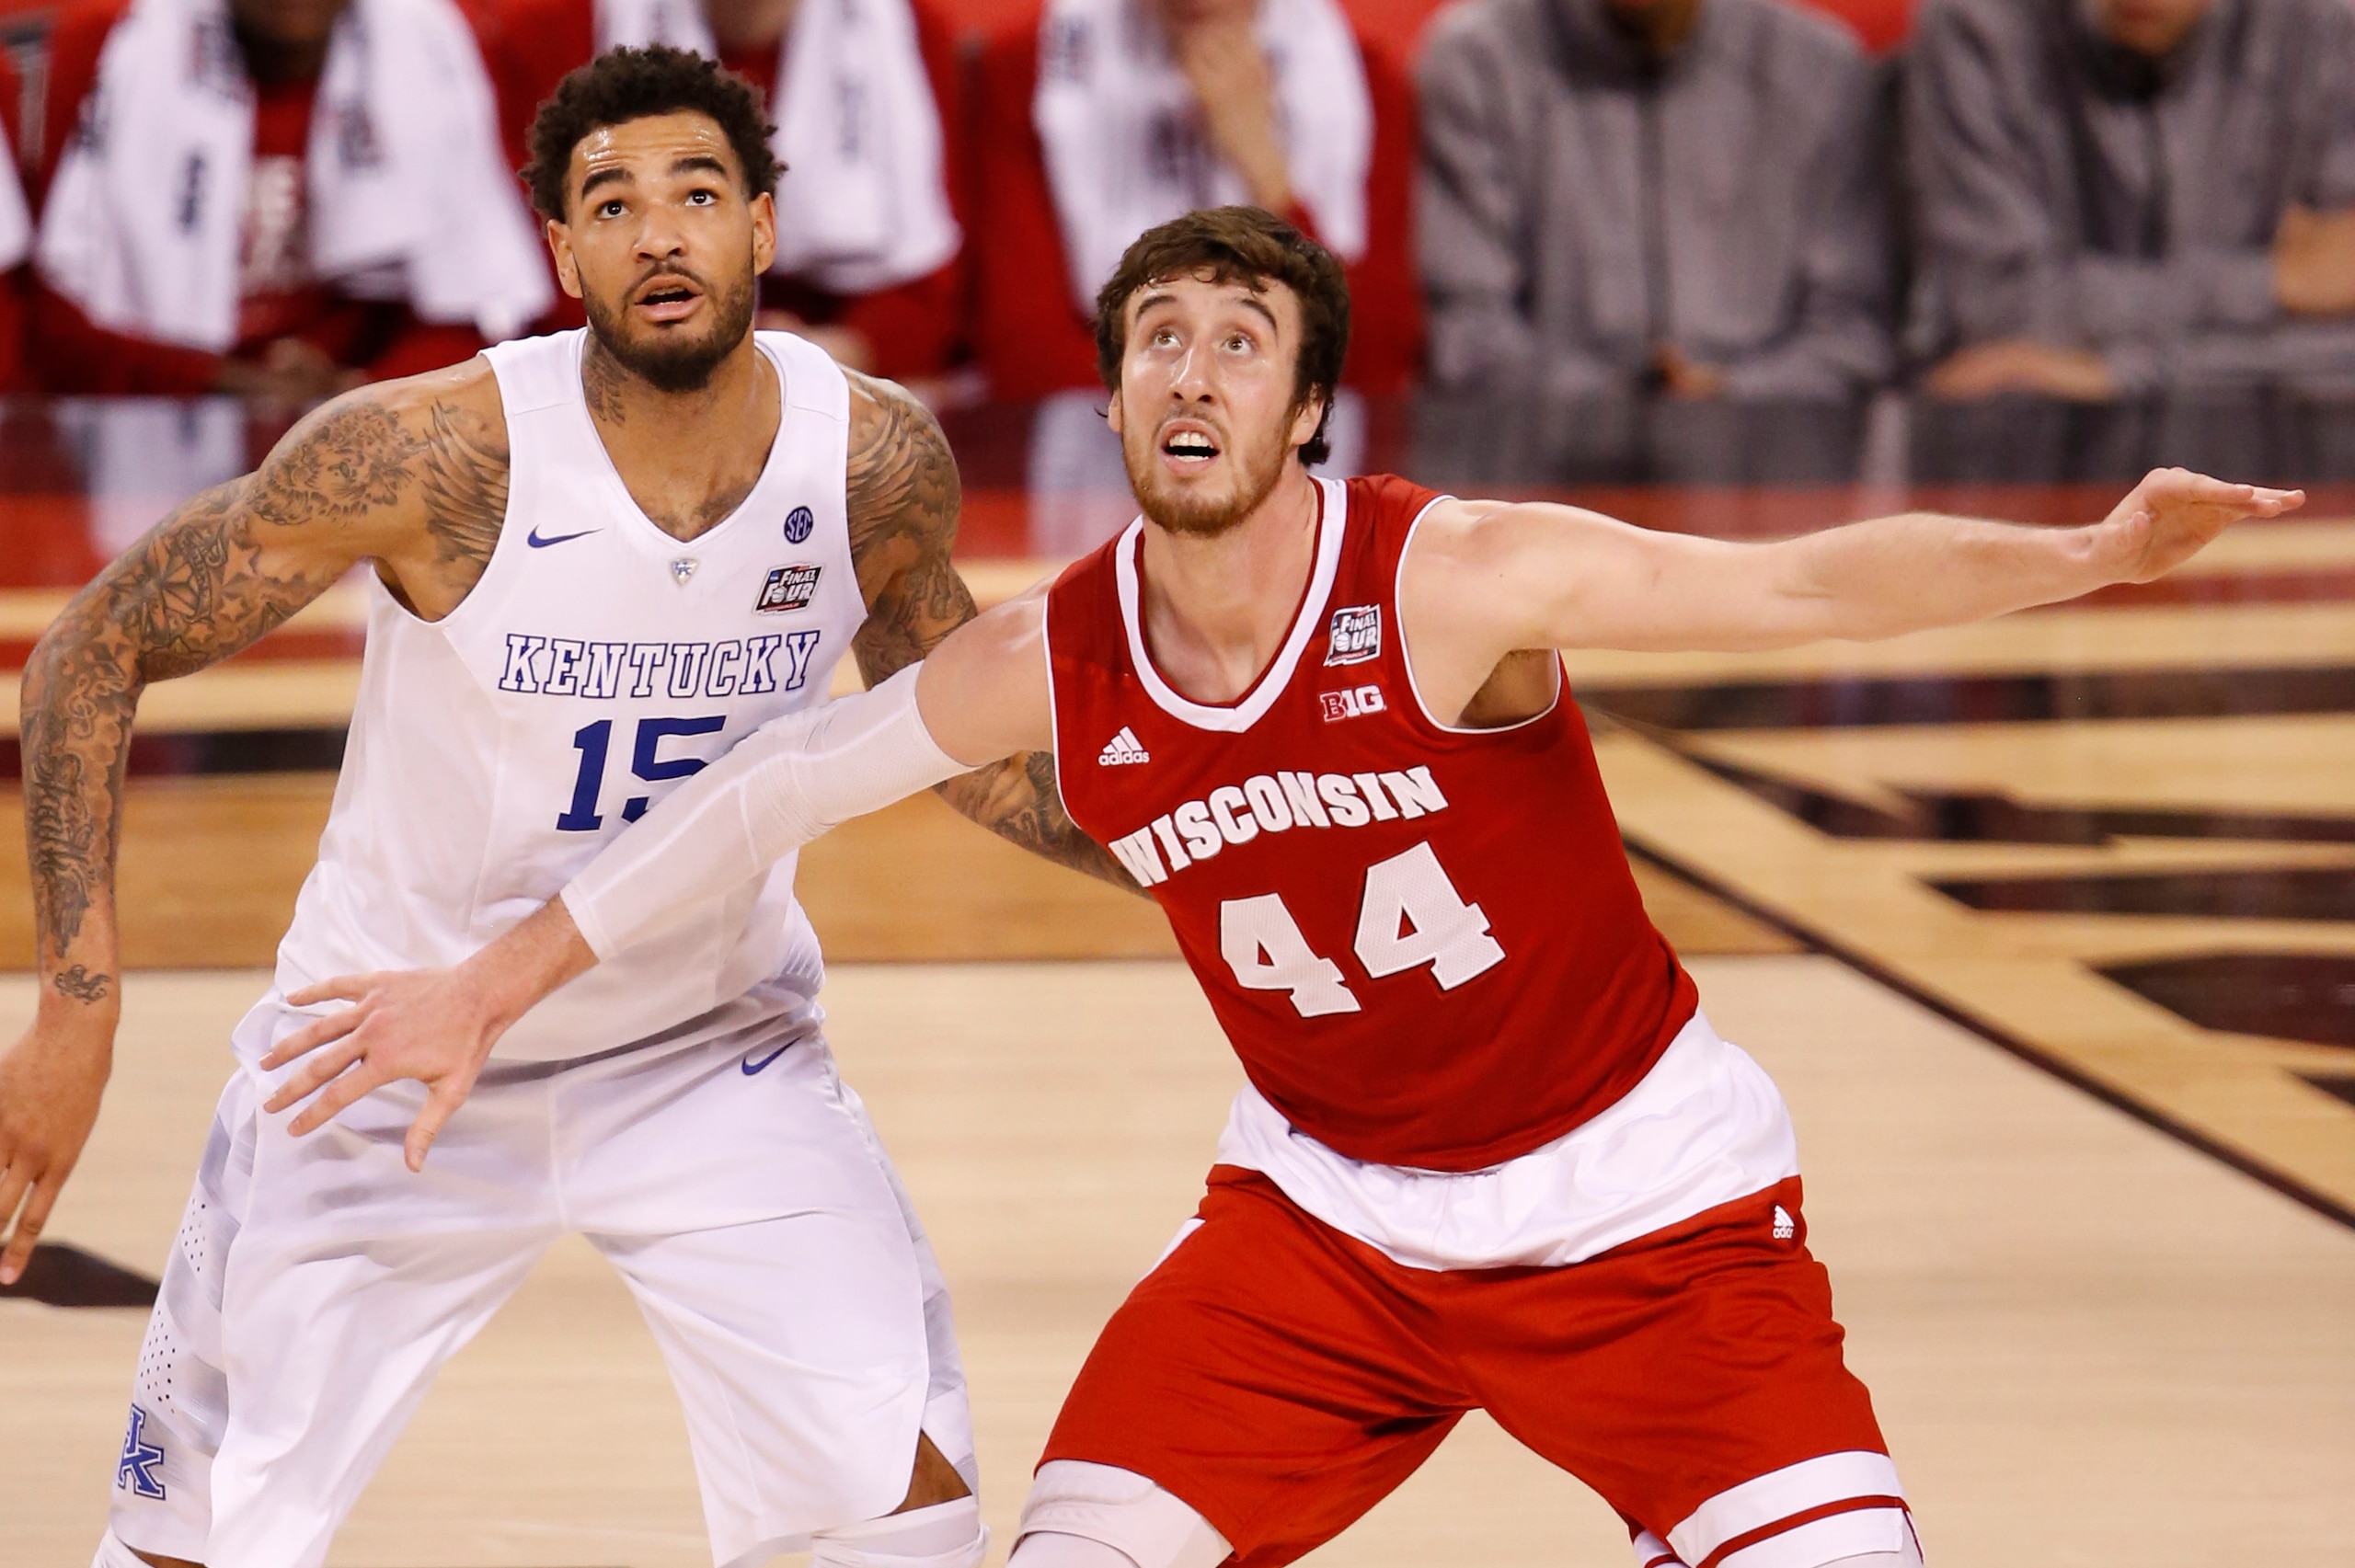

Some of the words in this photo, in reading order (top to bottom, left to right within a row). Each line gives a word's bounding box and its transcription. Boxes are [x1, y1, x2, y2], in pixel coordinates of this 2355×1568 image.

[787, 509, 811, 541] SEC
[780, 570, 817, 586] FINAL
[1340, 612, 1376, 632] FINAL
[499, 630, 821, 698] KENTUCKY
[556, 715, 727, 832] 15
[1098, 750, 1151, 766] adidas
[1108, 765, 1448, 888] WISCONSIN
[1220, 841, 1506, 1018] 44
